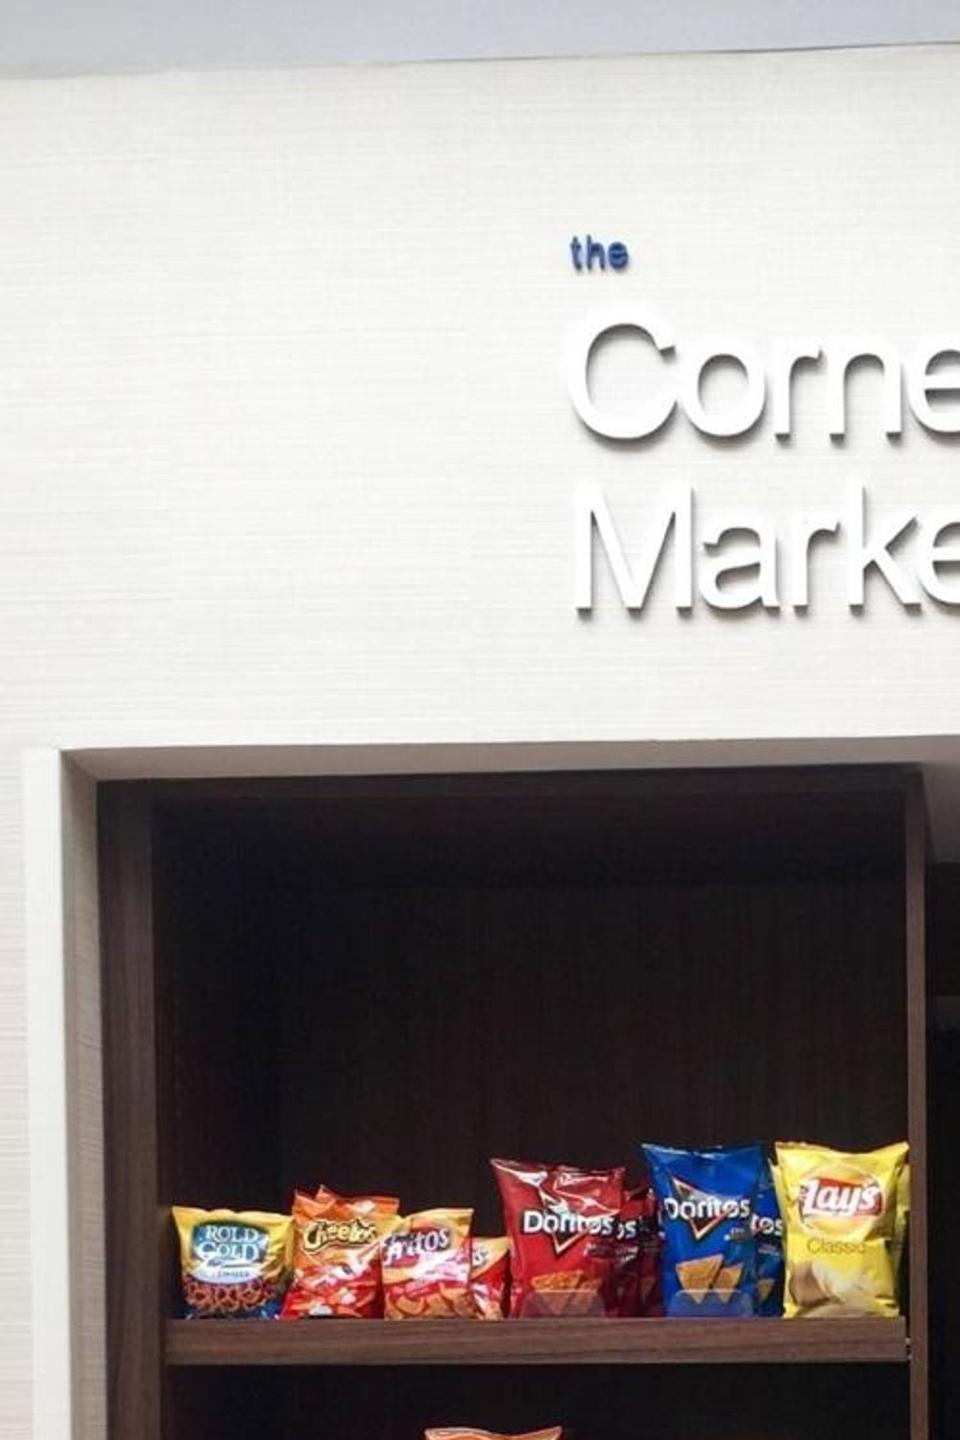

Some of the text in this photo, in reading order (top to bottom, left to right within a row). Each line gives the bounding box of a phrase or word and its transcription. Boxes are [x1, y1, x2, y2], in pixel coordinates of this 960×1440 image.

[569, 234, 630, 273] the
[663, 1196, 750, 1221] Doritos
[205, 1224, 260, 1243] ROLD
[302, 1218, 379, 1252] Cheetos
[522, 1209, 614, 1237] Doritos
[194, 1241, 260, 1262] GOLD
